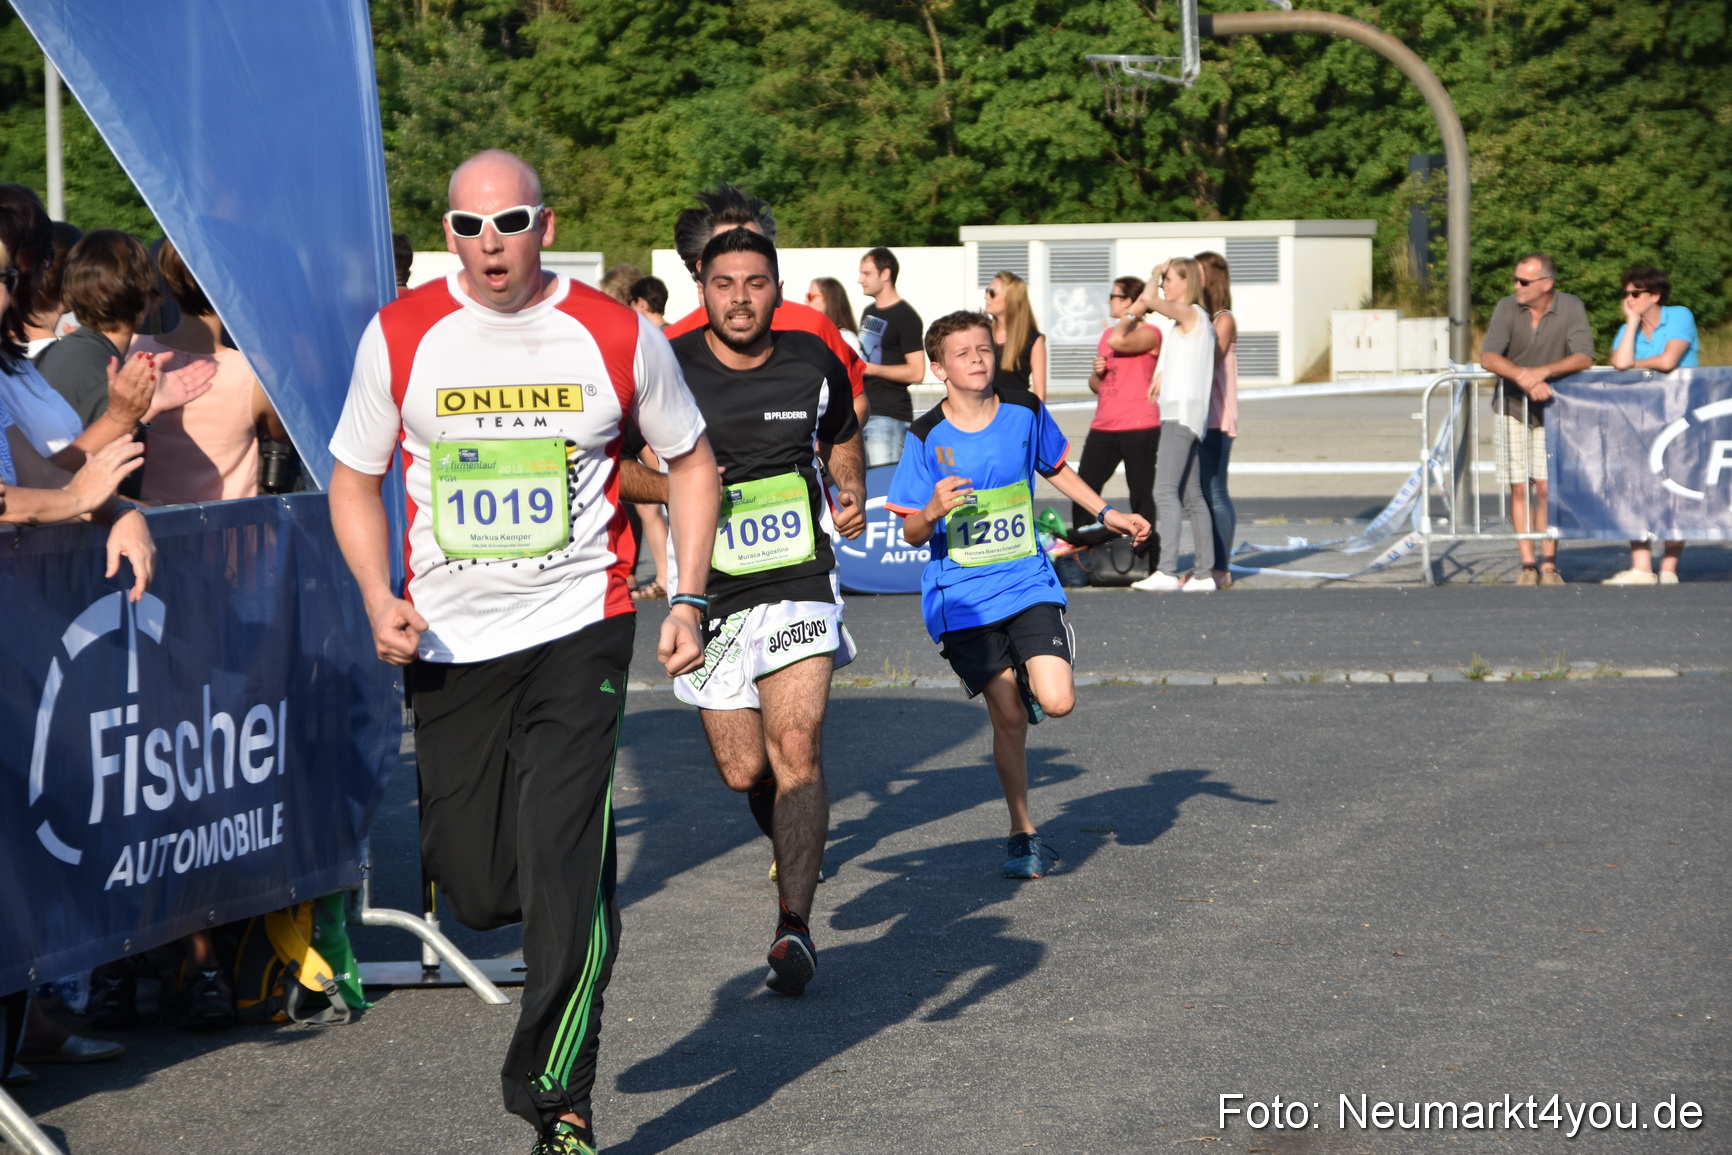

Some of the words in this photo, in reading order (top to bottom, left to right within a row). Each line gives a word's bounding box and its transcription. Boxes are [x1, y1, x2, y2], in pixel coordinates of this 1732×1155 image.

[444, 387, 571, 411] ONLINE
[476, 416, 547, 428] TEAM
[771, 411, 807, 420] PFLEIDERER
[450, 460, 497, 470] firmenlauf
[447, 487, 553, 526] 1019
[719, 510, 802, 550] 1089
[956, 513, 1026, 546] 1286
[469, 533, 499, 541] Markus
[500, 533, 532, 542] Kemper
[737, 551, 761, 561] Muraca
[761, 546, 789, 558] Agostino
[986, 543, 1021, 554] Bierschneider
[880, 549, 932, 564] AUTO
[726, 647, 743, 665] Gym
[103, 802, 284, 891] AUTOMOBILE
